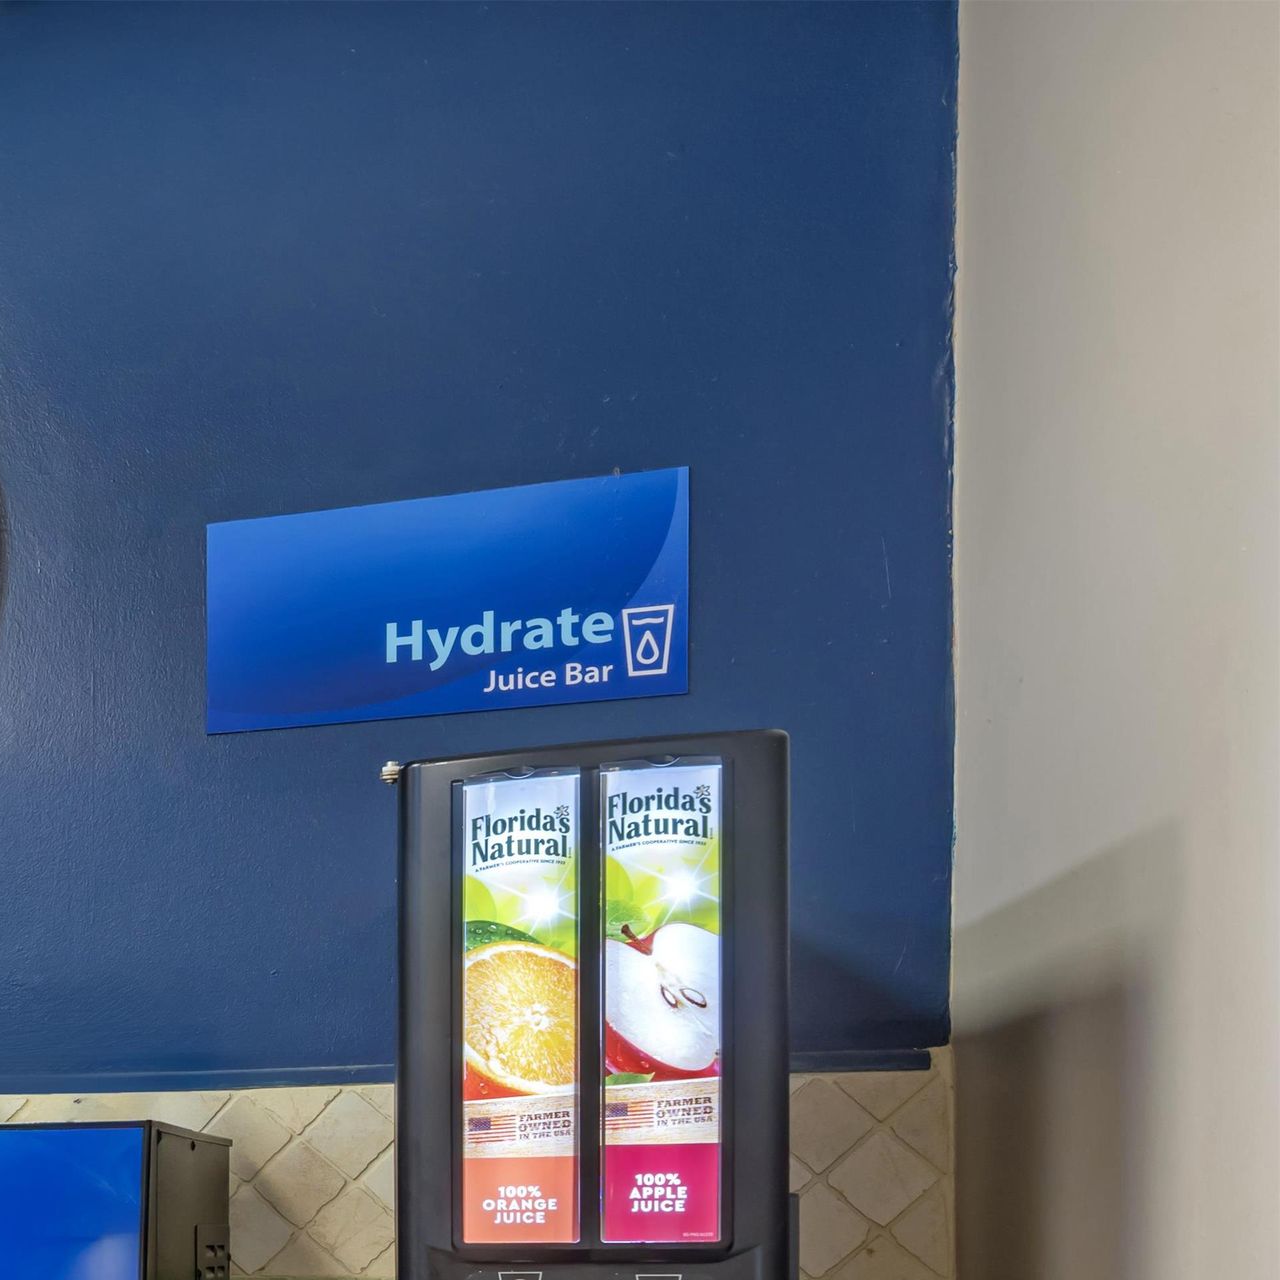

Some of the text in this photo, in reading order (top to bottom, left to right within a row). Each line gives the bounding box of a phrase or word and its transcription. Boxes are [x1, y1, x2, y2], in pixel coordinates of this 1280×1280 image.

[385, 607, 614, 671] Hydrate
[483, 662, 613, 693] Juice Bar
[608, 814, 708, 845] Natural
[471, 834, 567, 866] Natural
[656, 1096, 712, 1109] FARMER
[519, 1110, 570, 1122] FARMER
[656, 1105, 714, 1118] OWNED
[519, 1119, 571, 1132] OWNED
[657, 1118, 669, 1126] IN
[694, 1115, 713, 1123] USA
[553, 1129, 571, 1137] USA
[634, 1173, 681, 1186] 100%
[498, 1185, 542, 1198] 100%
[629, 1186, 688, 1199] APPLE
[482, 1198, 558, 1211] ORANGE
[631, 1200, 686, 1213] JUICE
[494, 1211, 546, 1224] JUICE
